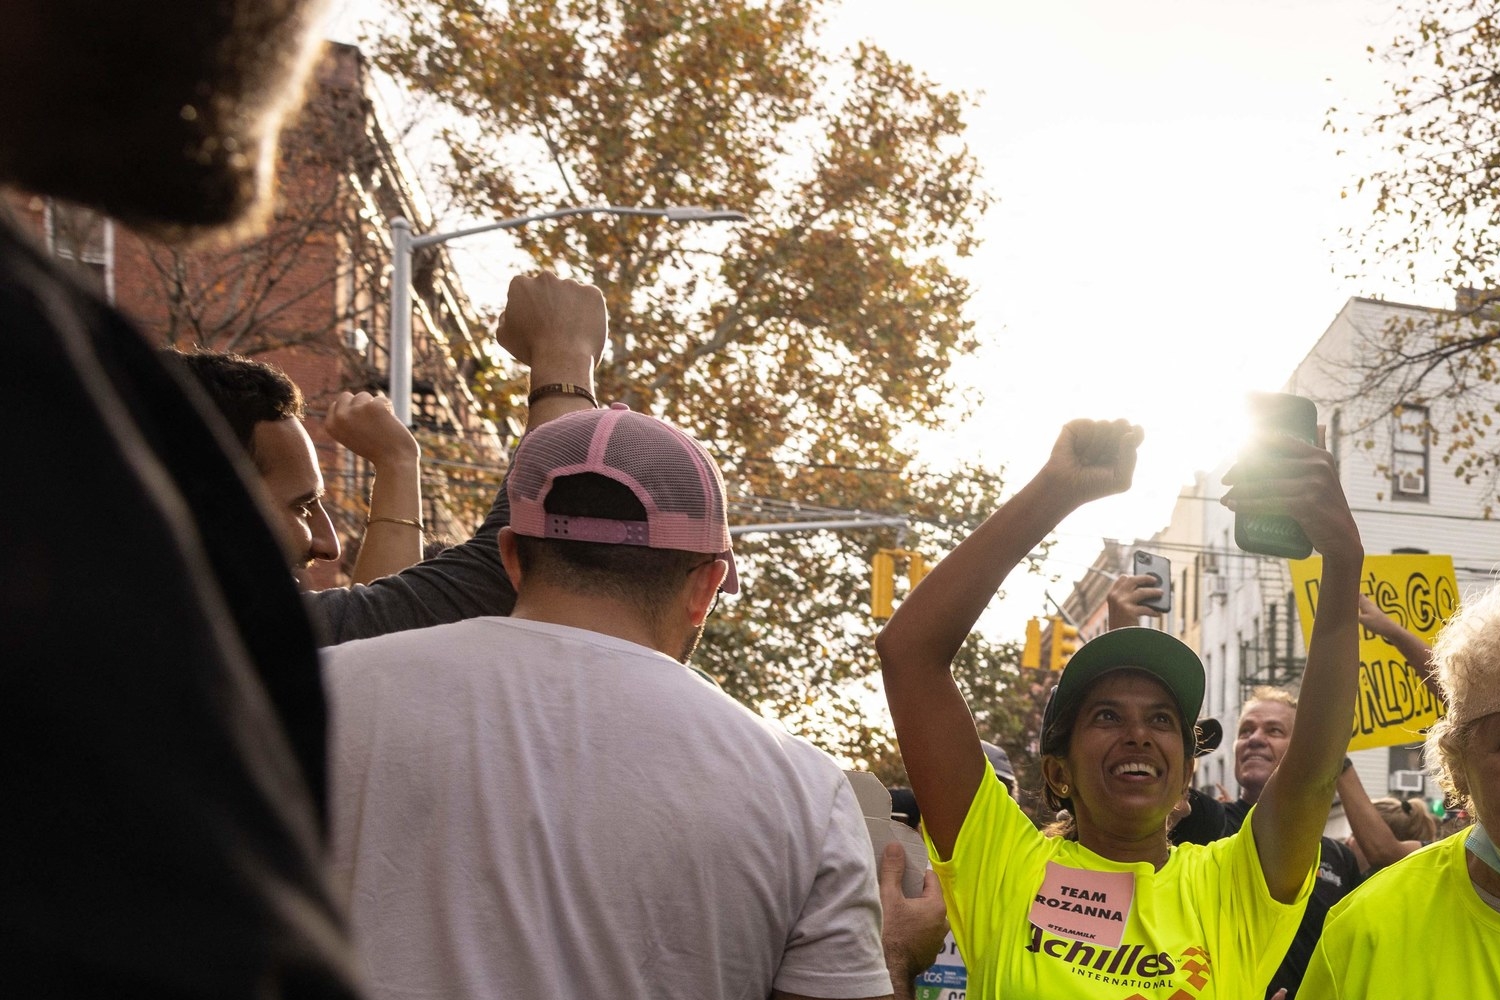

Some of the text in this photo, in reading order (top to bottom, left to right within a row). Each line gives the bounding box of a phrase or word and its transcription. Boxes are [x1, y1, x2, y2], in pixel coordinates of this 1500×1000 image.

[1060, 886, 1106, 903] TEAM
[1035, 894, 1123, 921] ROZANNA
[1047, 923, 1096, 940] #TEAMMILK
[1071, 966, 1174, 989] INTERNATIONAL
